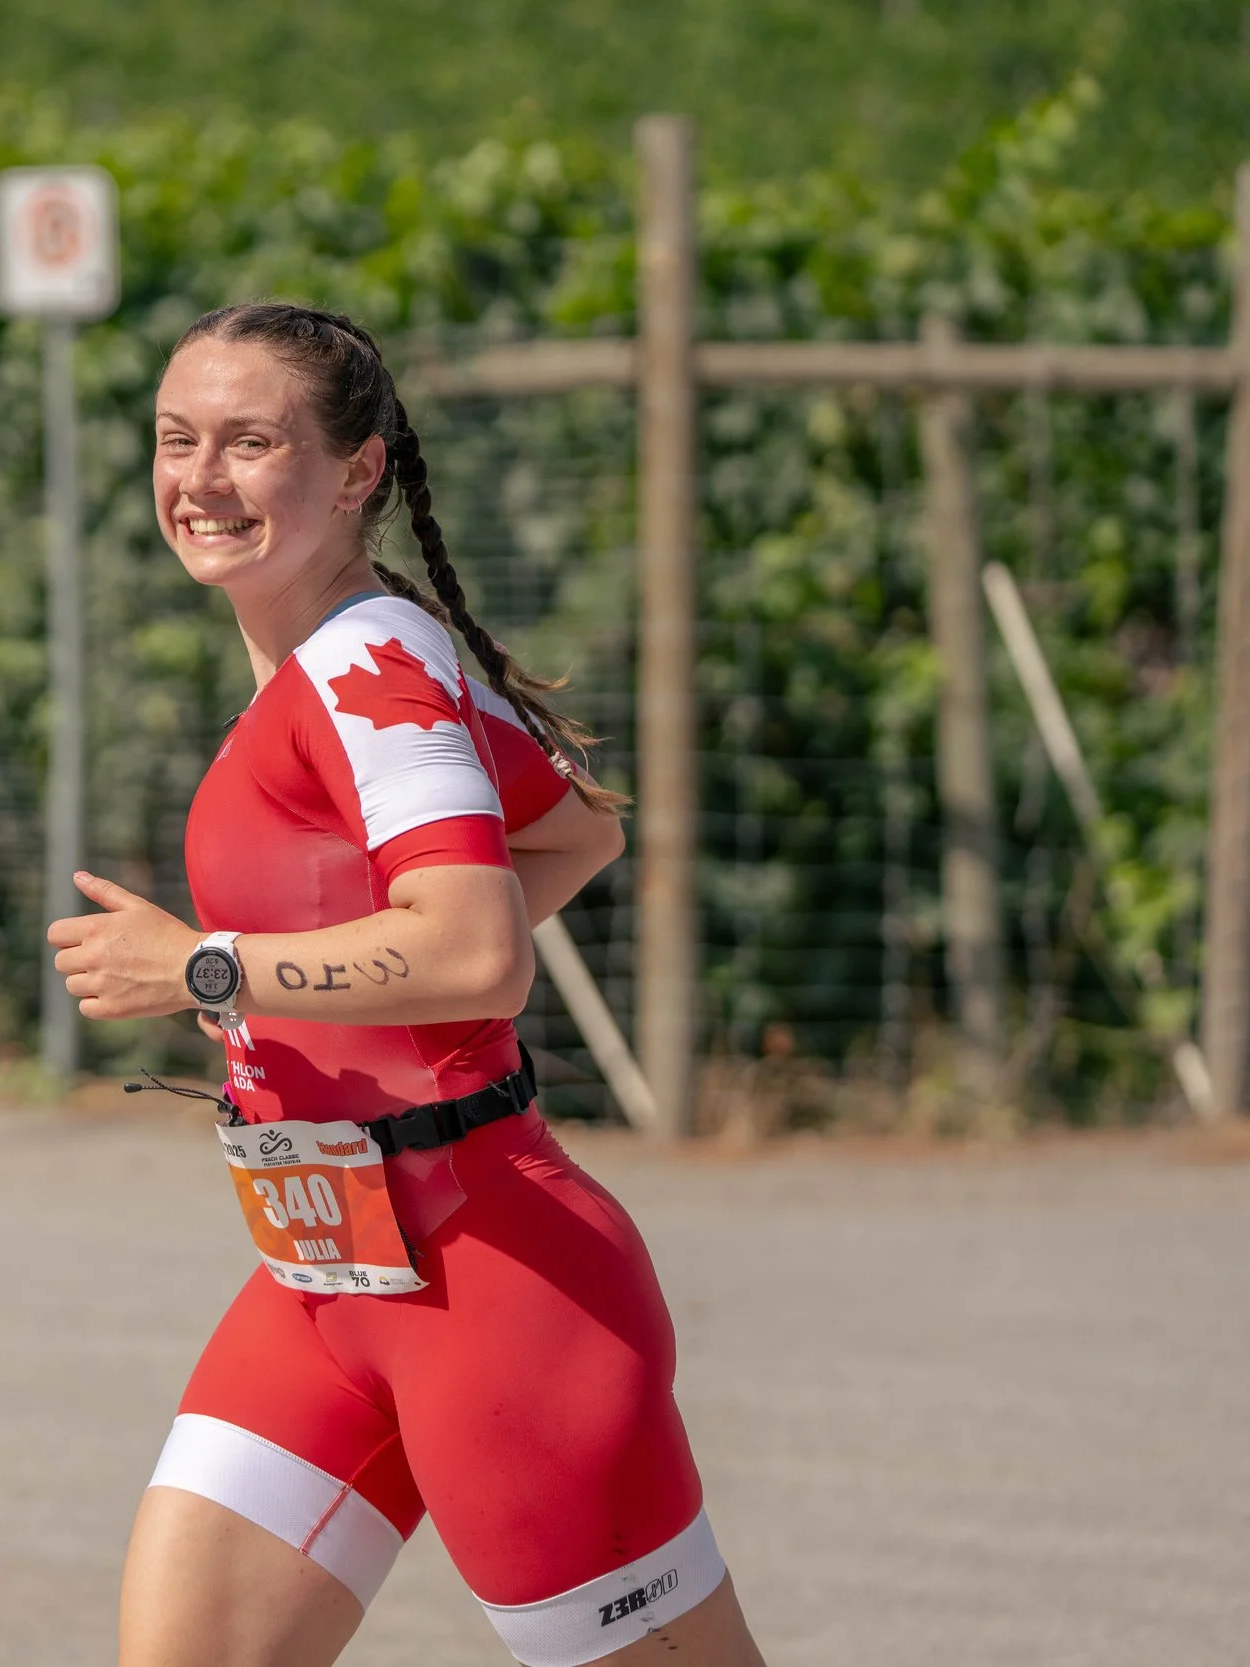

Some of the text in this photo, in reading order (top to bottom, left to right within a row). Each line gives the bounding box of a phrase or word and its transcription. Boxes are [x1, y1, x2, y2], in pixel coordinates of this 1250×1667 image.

[196, 968, 228, 980] 23:37
[253, 1174, 342, 1229] 340
[293, 1238, 342, 1261] JULIA
[351, 1277, 370, 1287] 70
